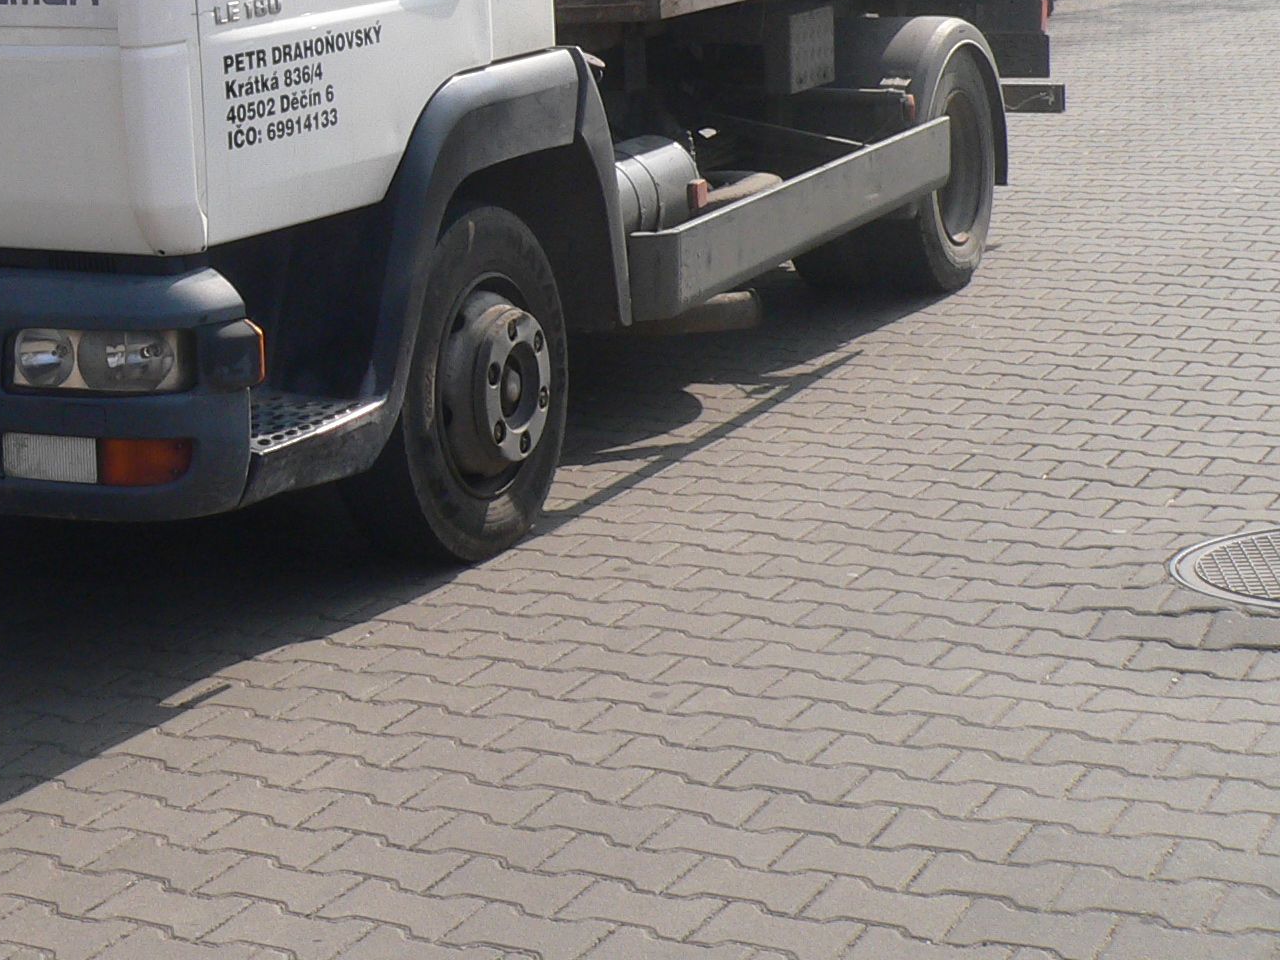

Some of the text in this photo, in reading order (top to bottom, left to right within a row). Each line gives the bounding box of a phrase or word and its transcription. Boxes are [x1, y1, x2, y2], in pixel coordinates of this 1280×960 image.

[213, 1, 240, 25] LE
[223, 20, 382, 74] PETR DRAHOŇOVSKÝ
[225, 62, 323, 99] Krátká 836/4
[227, 84, 334, 124] 40502 Děčín 6
[228, 107, 338, 150] IČO: 69914133
